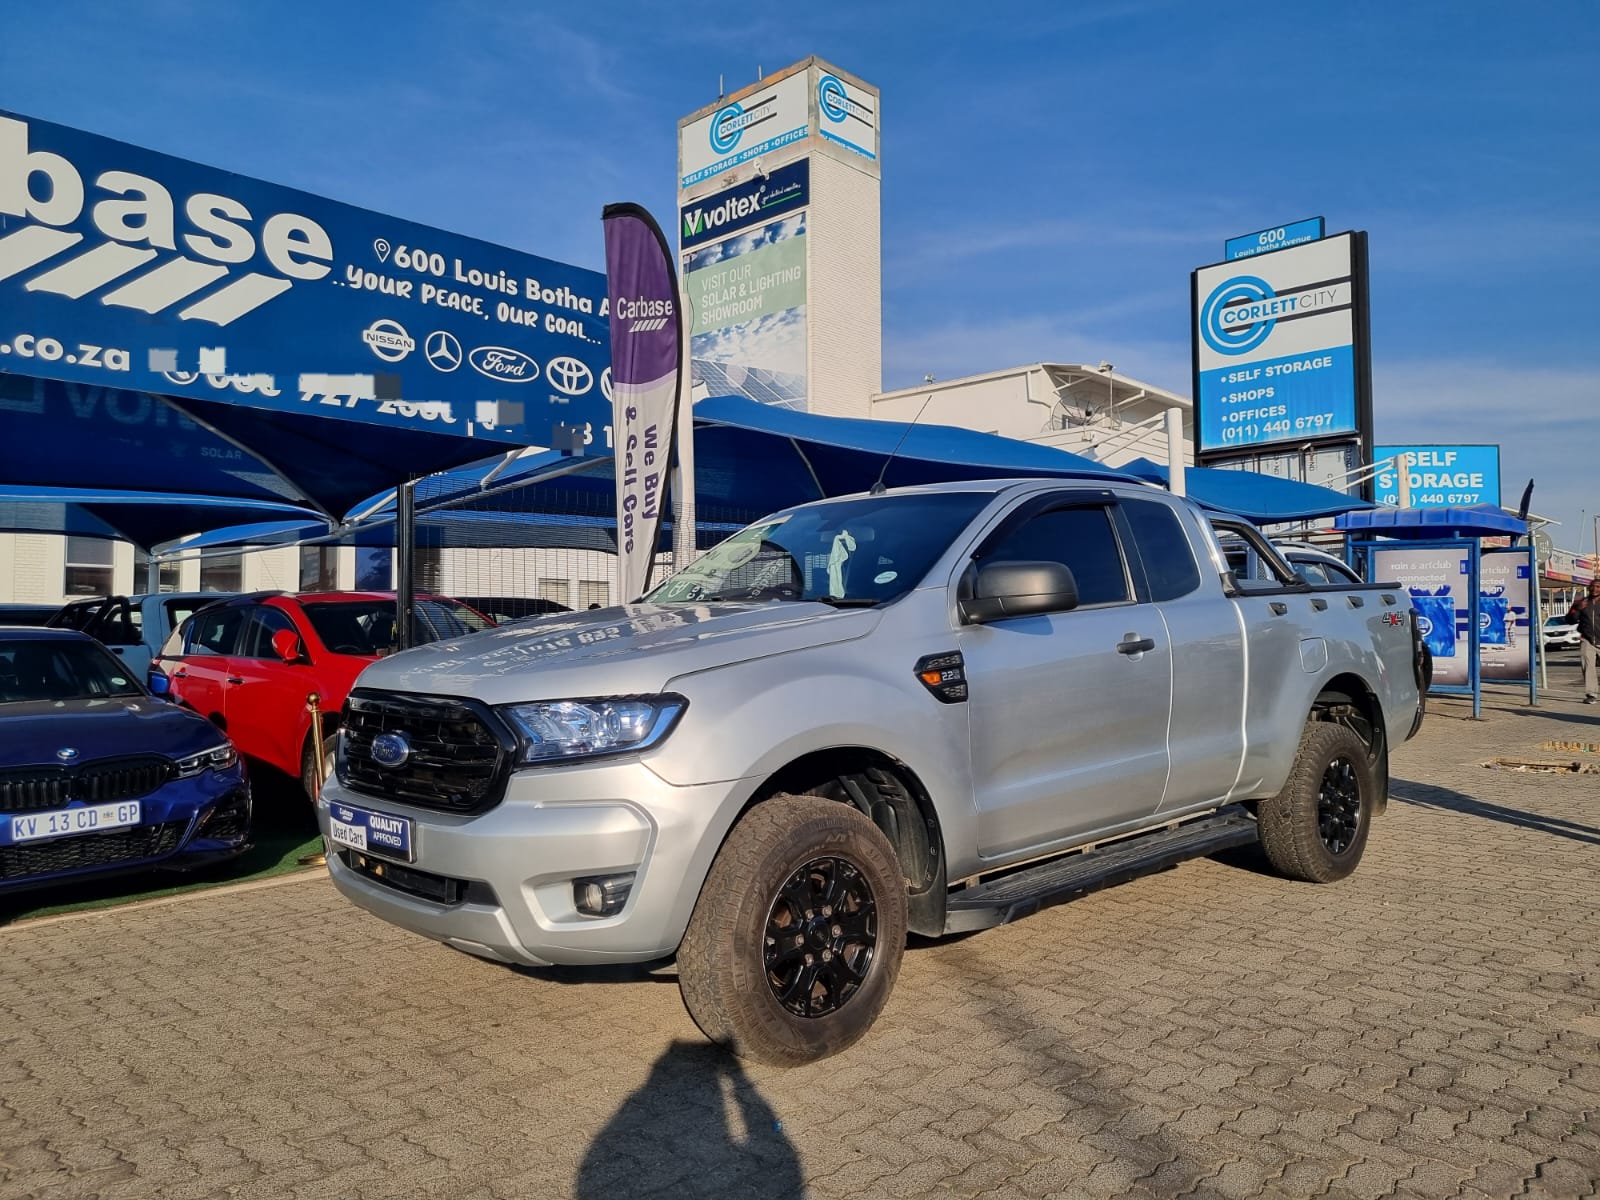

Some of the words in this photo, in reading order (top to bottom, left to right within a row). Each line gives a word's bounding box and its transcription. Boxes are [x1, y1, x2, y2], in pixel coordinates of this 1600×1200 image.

[703, 156, 738, 177] STORAGE
[742, 142, 769, 160] SHOPS
[774, 127, 808, 147] OFFICES
[1234, 246, 1255, 258] Louis
[1256, 241, 1280, 254] Botha
[1281, 234, 1312, 247] Avenue
[1259, 228, 1286, 245] 600
[394, 245, 446, 277] 600
[455, 258, 518, 295] Louis
[525, 278, 592, 314] Botha
[701, 270, 726, 291] VISIT
[730, 264, 752, 282] OUR
[701, 289, 736, 309] SOLAR
[738, 284, 747, 297] &
[750, 266, 801, 293] LIGHTING
[497, 302, 538, 328] OUR
[616, 296, 674, 320] Carbase
[701, 296, 763, 326] SHOWROOM
[366, 331, 413, 349] NISSAN
[482, 351, 527, 377] Ford
[1228, 367, 1262, 384] SELF
[1265, 356, 1333, 377] STORAGE
[1229, 386, 1276, 403] SHOPS
[1229, 405, 1287, 423] OFFICES
[1221, 424, 1259, 442] (011)
[1262, 419, 1291, 433] 440
[1295, 413, 1334, 430] 6797
[643, 423, 658, 467] We
[1406, 451, 1457, 467] SELF
[1378, 473, 1484, 489] SORAGE
[641, 471, 659, 519] Buy
[1383, 494, 1417, 505] (0)
[1420, 494, 1444, 504] 440
[1447, 494, 1479, 504] 6797
[622, 494, 638, 554] Cars
[15, 818, 37, 837] KV
[49, 814, 70, 832] 13
[77, 809, 98, 828] CD
[118, 804, 138, 822] GP
[370, 815, 403, 834] QUALITY
[333, 822, 348, 840] Used
[349, 827, 364, 846] Cars
[373, 831, 402, 847] APPROVED
